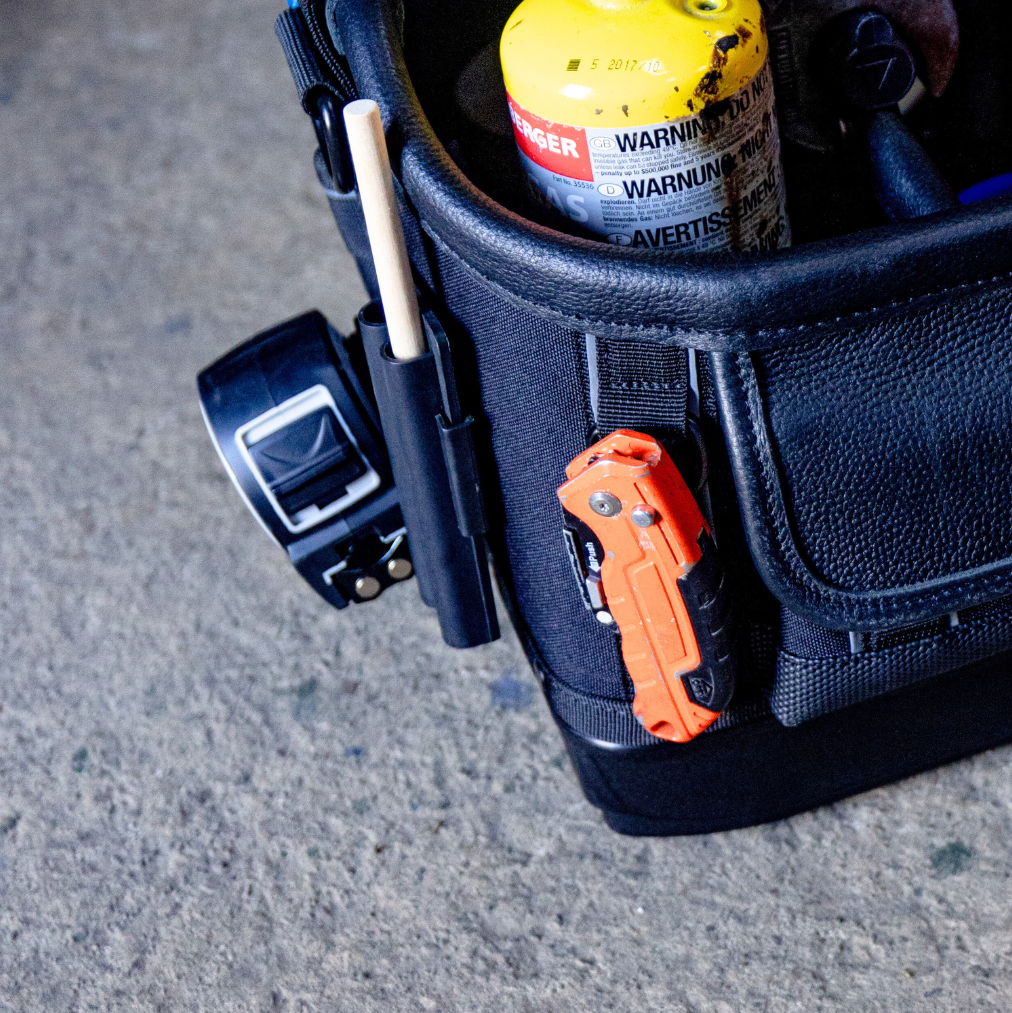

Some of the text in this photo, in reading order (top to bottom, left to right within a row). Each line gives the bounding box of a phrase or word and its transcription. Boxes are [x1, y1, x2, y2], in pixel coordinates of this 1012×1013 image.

[593, 139, 612, 148] GB
[573, 180, 595, 190] 35536
[606, 185, 615, 194] D
